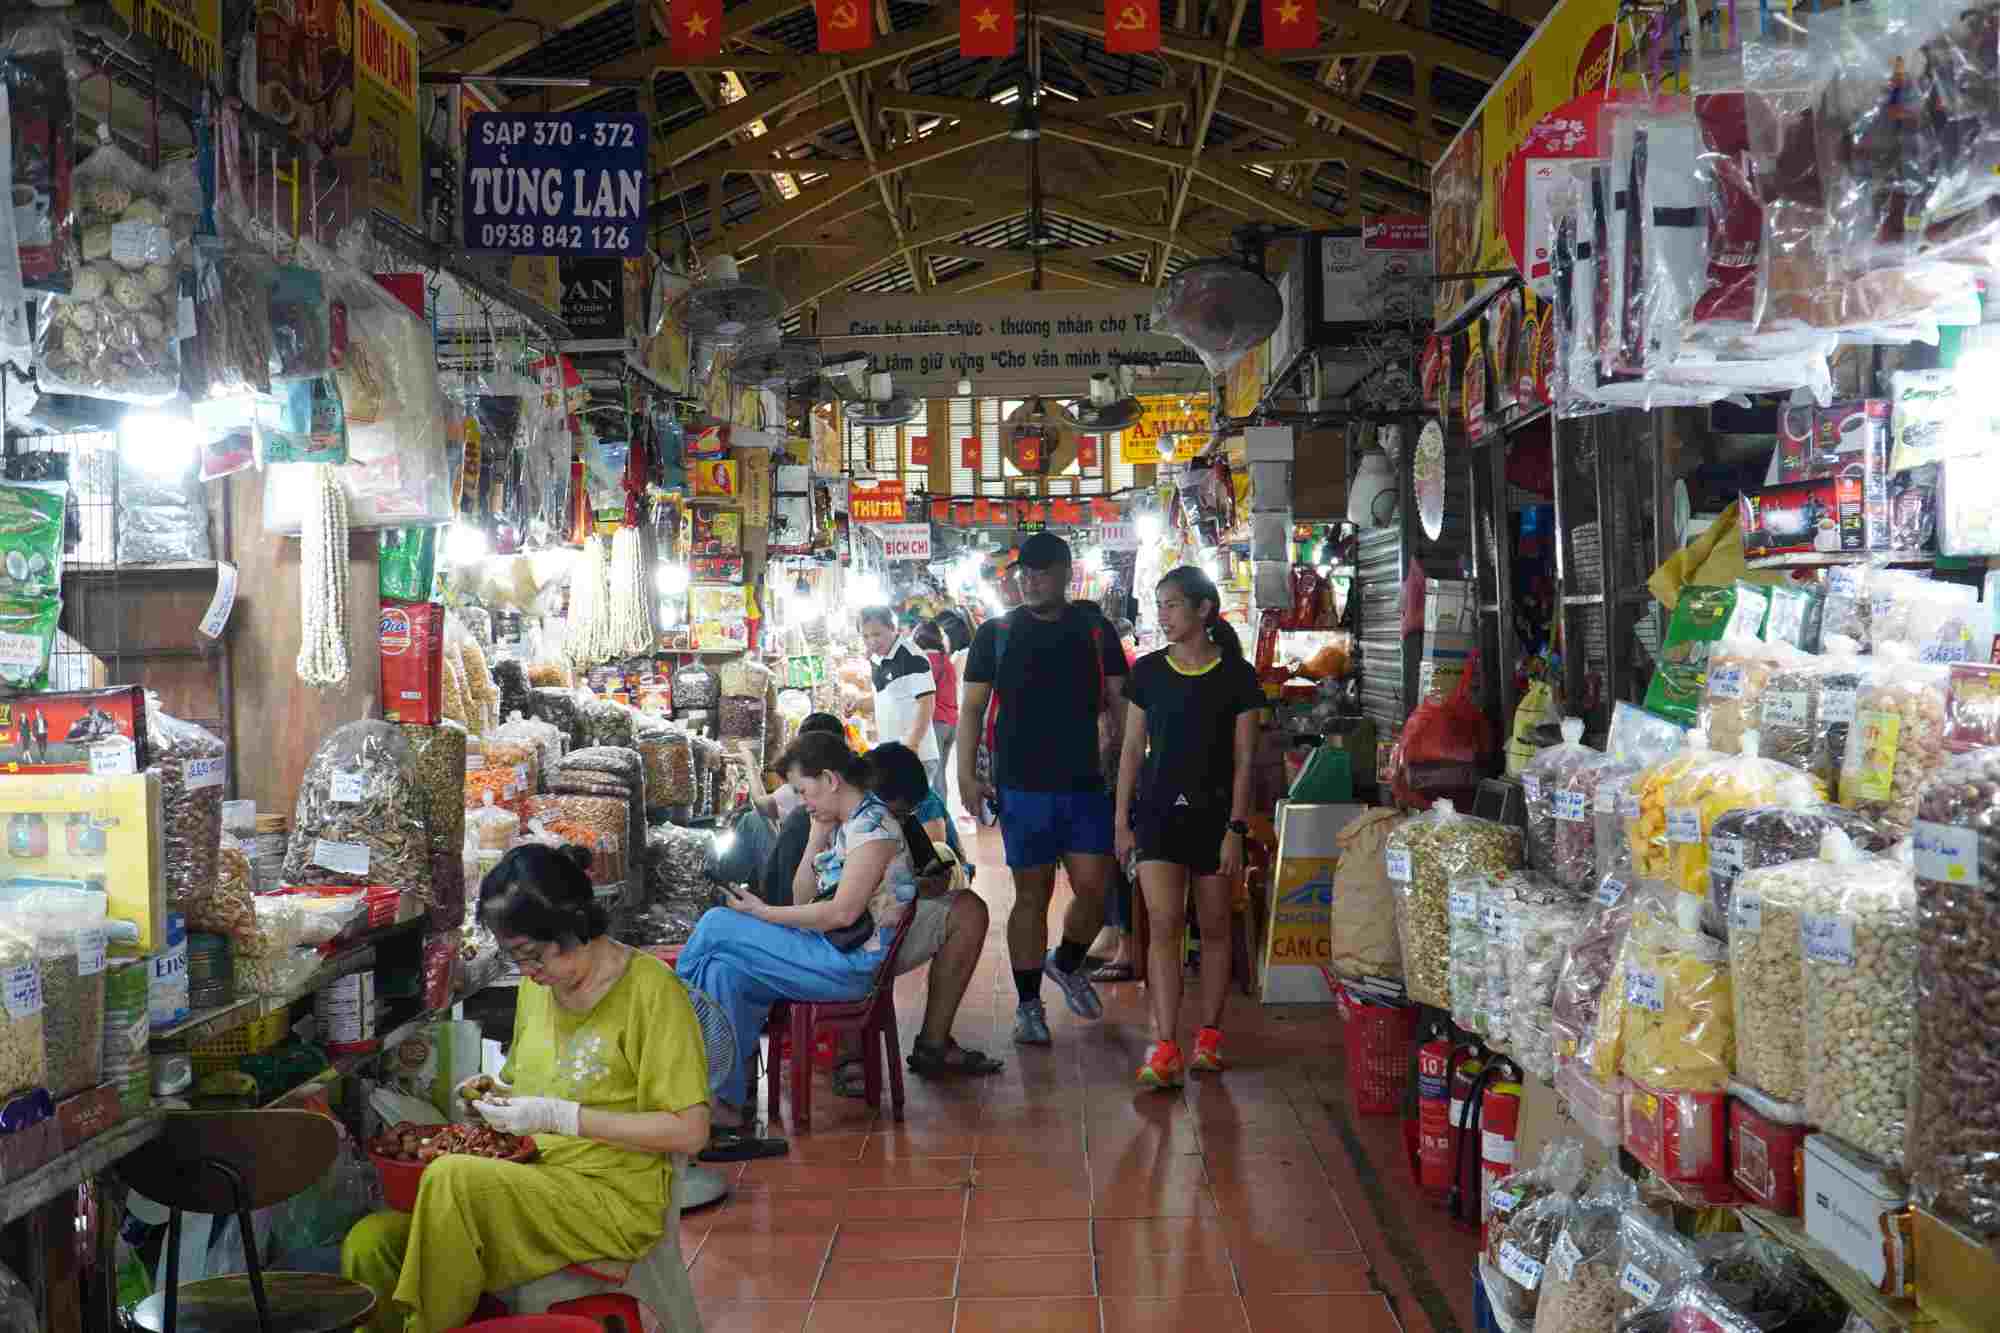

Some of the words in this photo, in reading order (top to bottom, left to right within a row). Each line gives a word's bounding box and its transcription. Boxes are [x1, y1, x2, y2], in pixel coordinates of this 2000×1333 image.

[533, 122, 572, 146] 370
[593, 123, 634, 147] 372
[471, 153, 563, 216] TÙNG
[573, 169, 642, 218] LAN
[481, 224, 534, 248] 0938
[542, 225, 582, 248] 842
[592, 227, 629, 249] 126
